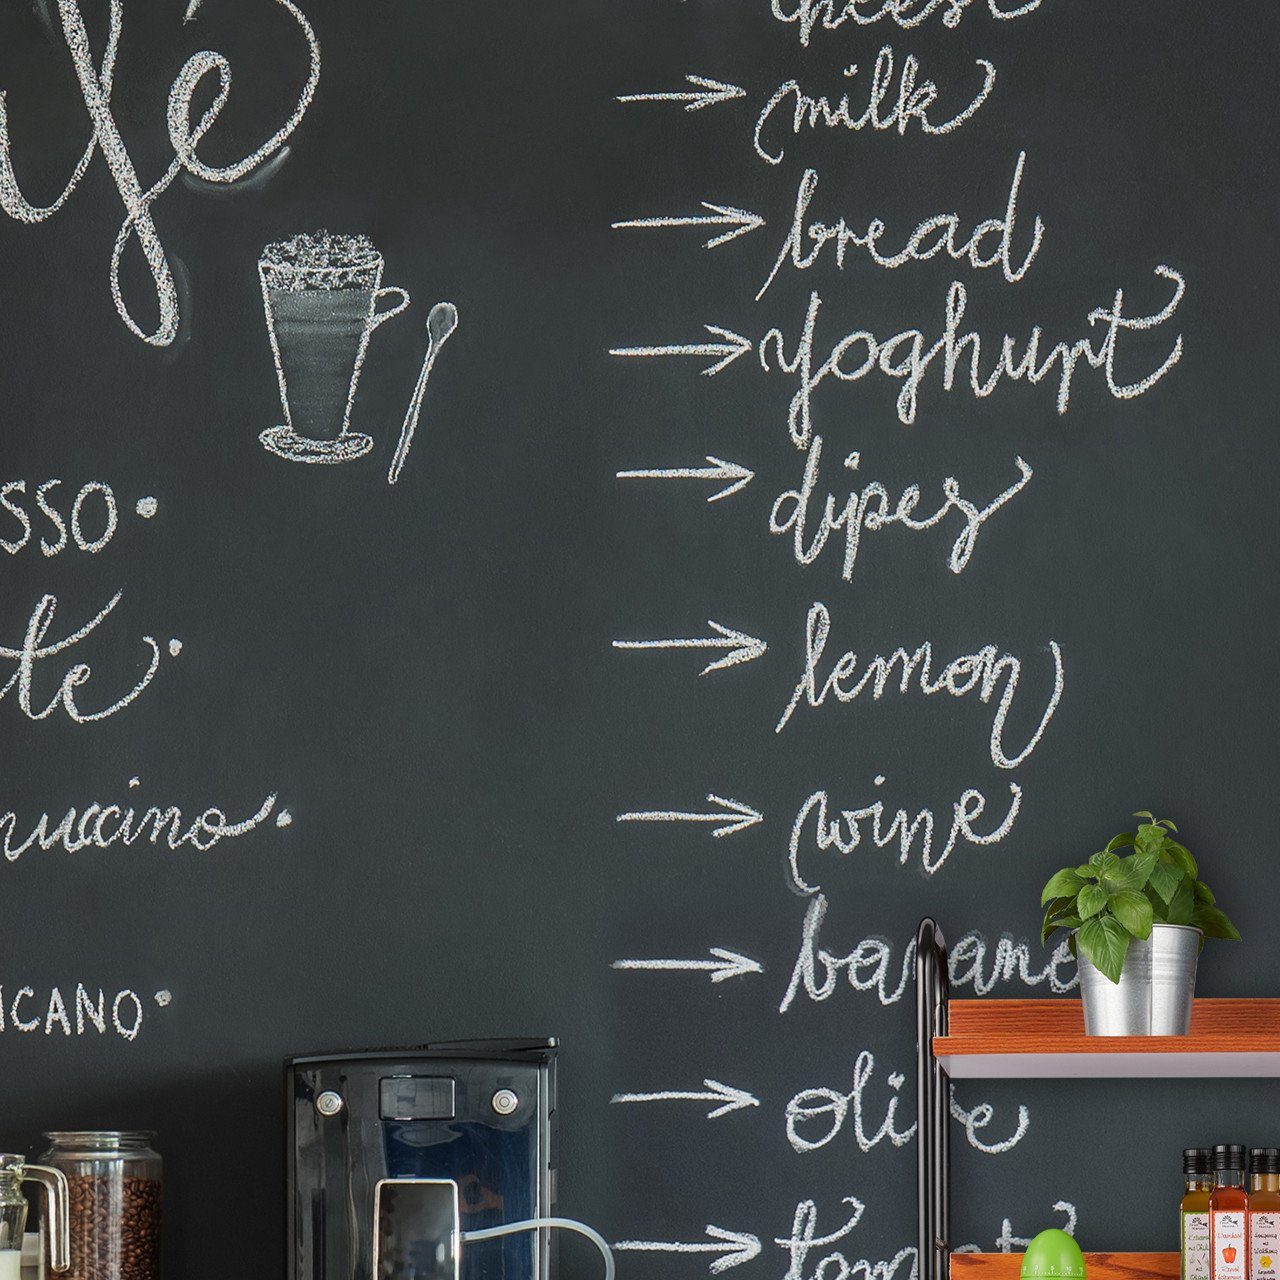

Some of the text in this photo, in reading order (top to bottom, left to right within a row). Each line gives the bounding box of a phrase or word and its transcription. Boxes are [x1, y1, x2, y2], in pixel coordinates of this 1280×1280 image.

[754, 45, 996, 165] milk
[756, 151, 1045, 301] bread
[758, 265, 1185, 449] yoghurt
[776, 602, 1064, 769] lemon
[789, 775, 1022, 893] wine
[785, 1051, 1030, 1154] olie
